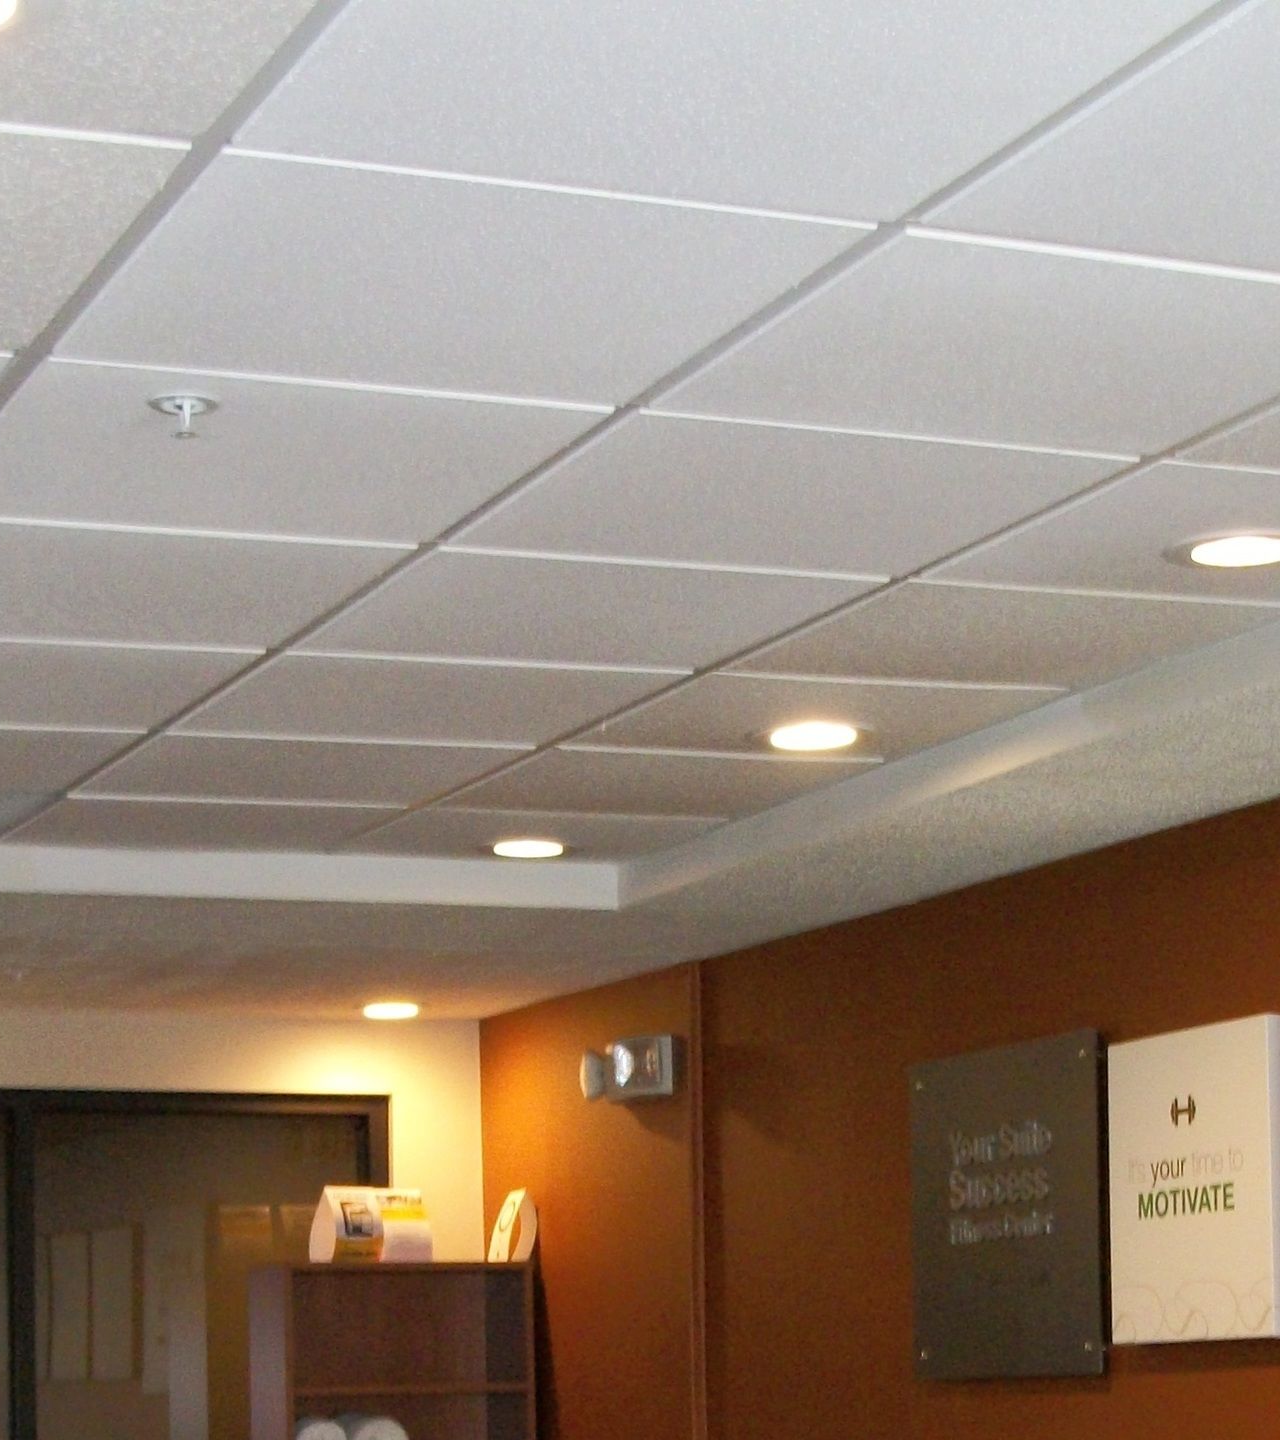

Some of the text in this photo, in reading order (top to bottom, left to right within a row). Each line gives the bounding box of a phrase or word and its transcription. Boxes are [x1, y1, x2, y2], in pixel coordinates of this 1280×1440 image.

[949, 1130, 996, 1167] Your
[1151, 1157, 1186, 1188] your
[1191, 1150, 1224, 1177] time
[1228, 1146, 1244, 1172] to
[949, 1168, 1050, 1210] Success
[1138, 1182, 1235, 1220] MOTIVATE
